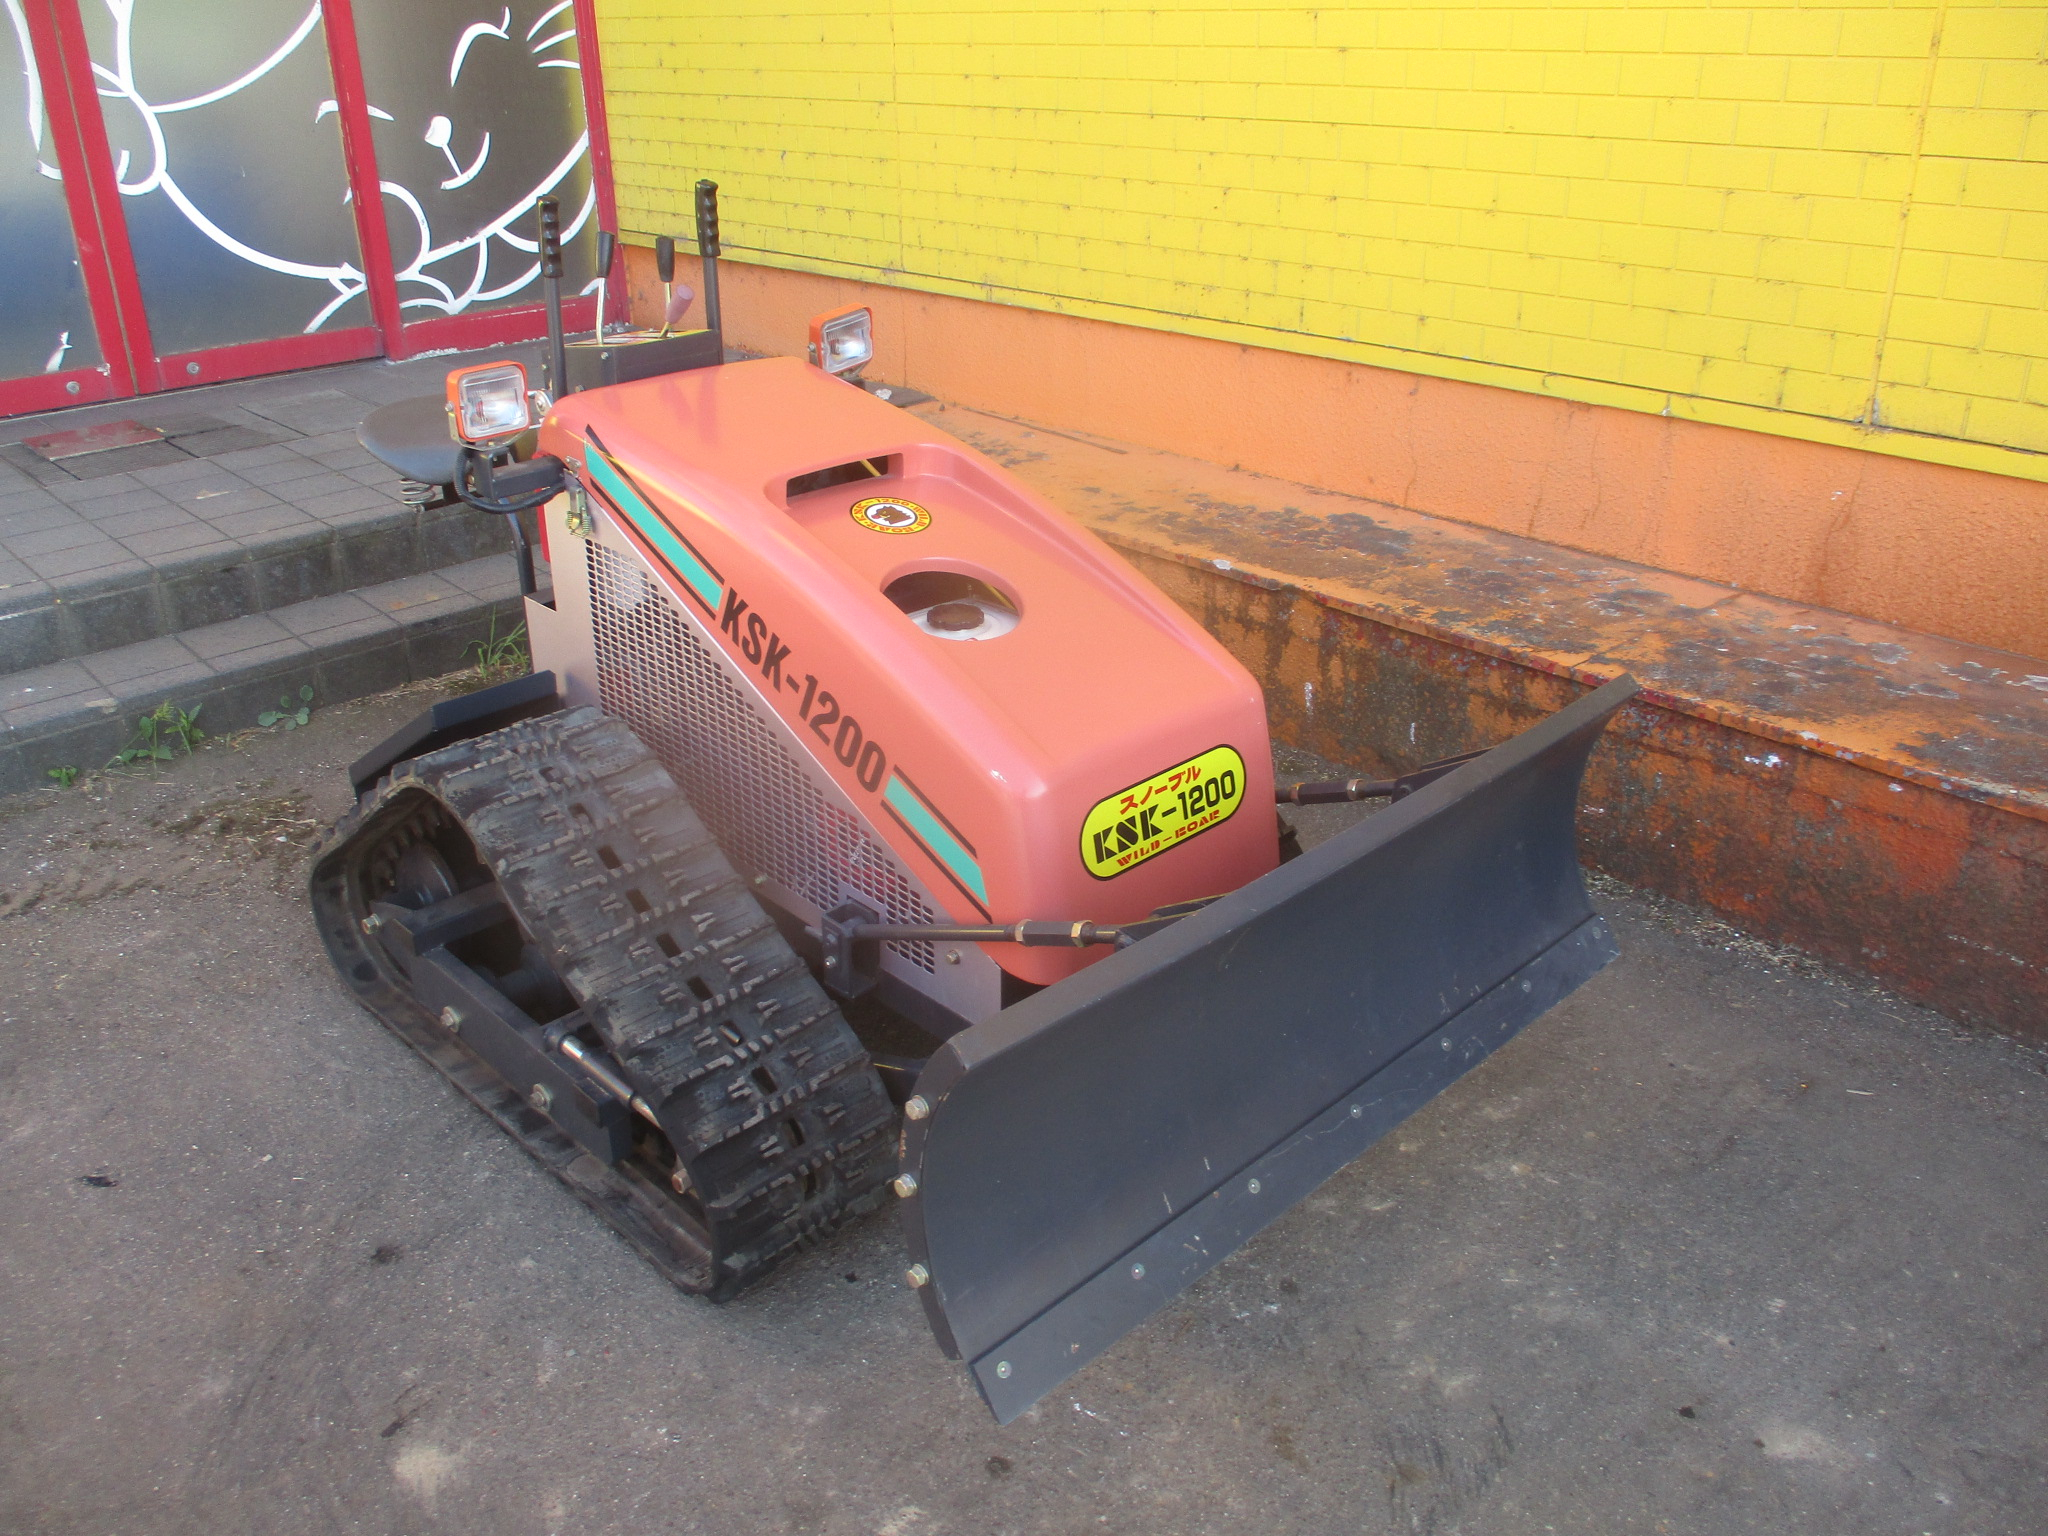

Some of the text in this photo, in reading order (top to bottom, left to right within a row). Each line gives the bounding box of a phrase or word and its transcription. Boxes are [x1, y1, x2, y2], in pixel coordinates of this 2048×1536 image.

[720, 587, 887, 793] KSK-1200
[1092, 769, 1237, 865] KSK-1200
[1119, 765, 1202, 815] スノーブル
